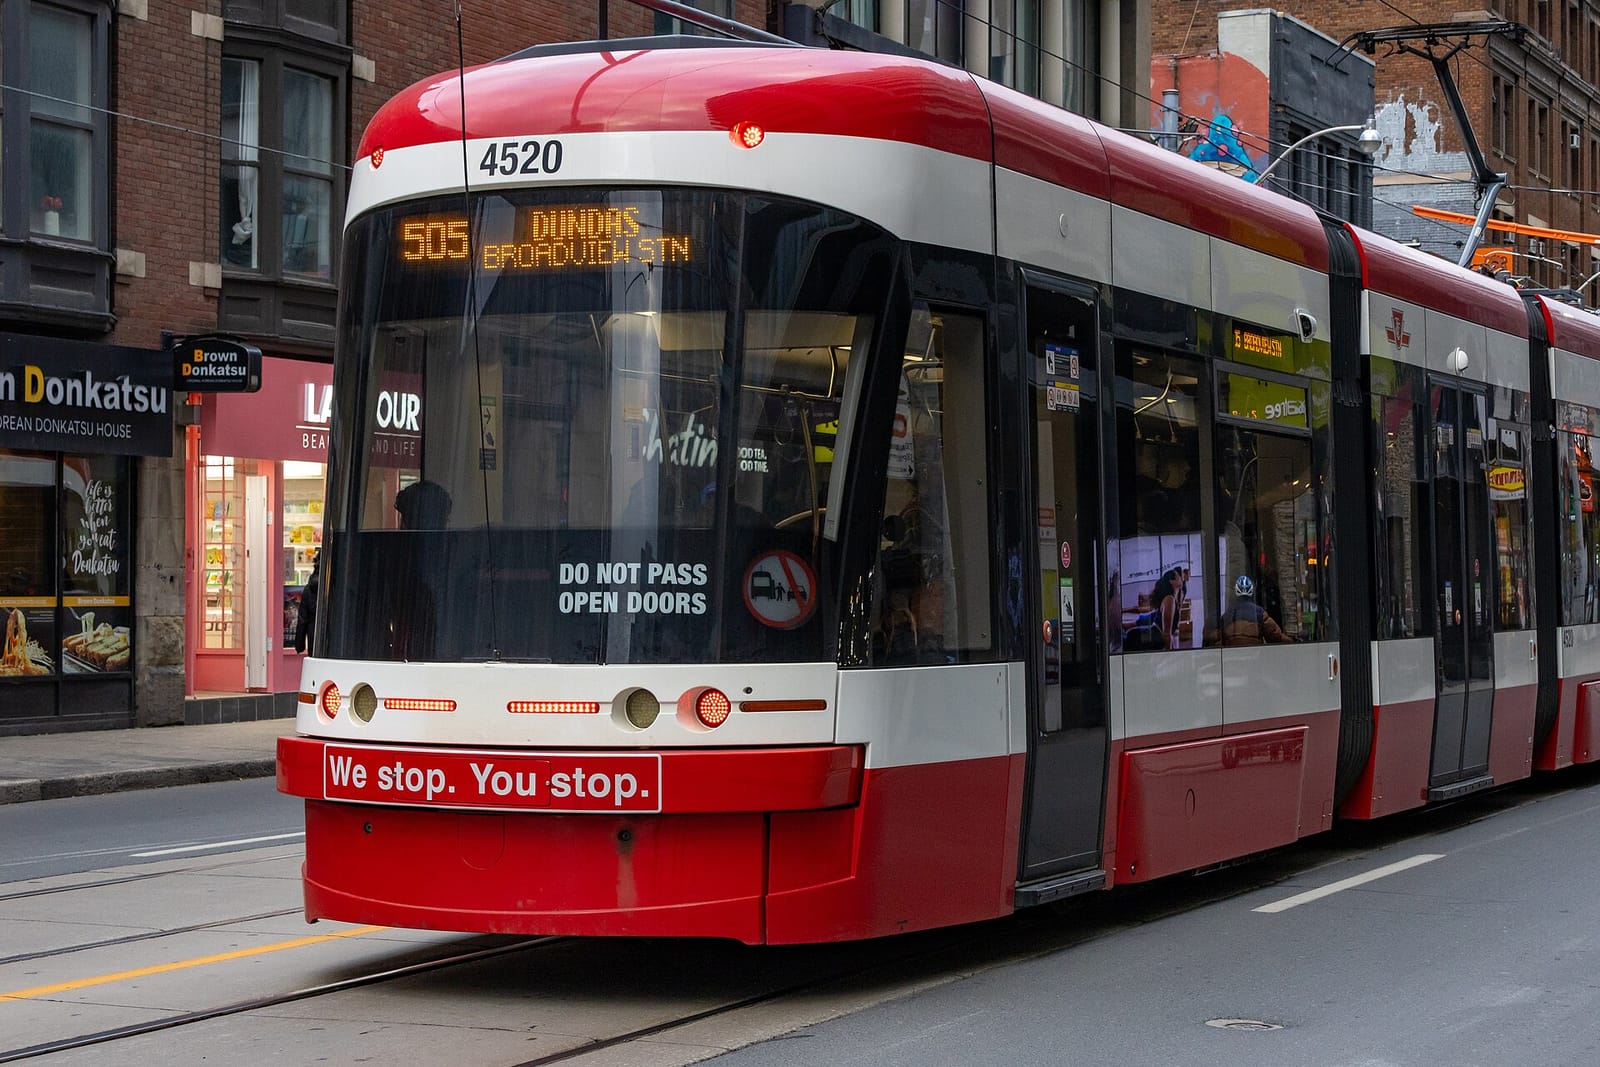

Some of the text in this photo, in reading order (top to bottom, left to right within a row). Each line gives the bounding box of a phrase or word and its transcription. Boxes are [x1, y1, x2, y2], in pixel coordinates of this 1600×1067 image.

[479, 139, 563, 176] 4520
[532, 206, 640, 241] DUNDAS
[404, 221, 468, 260] 505
[484, 236, 689, 269] BROADVIEW STN
[193, 348, 238, 362] Brown
[181, 362, 247, 377] Donkatsu
[24, 364, 167, 414] Donkatsu
[35, 417, 94, 437] DONKATSU
[96, 422, 132, 439] HOUSE
[302, 433, 330, 449] BEA
[393, 440, 416, 457] LIFE
[85, 497, 113, 515] better
[72, 549, 120, 576] Donkatsu
[559, 563, 708, 586] DO NOT PASS
[558, 591, 707, 614] OPEN DOORS
[329, 755, 649, 806] We stop. You stop.
